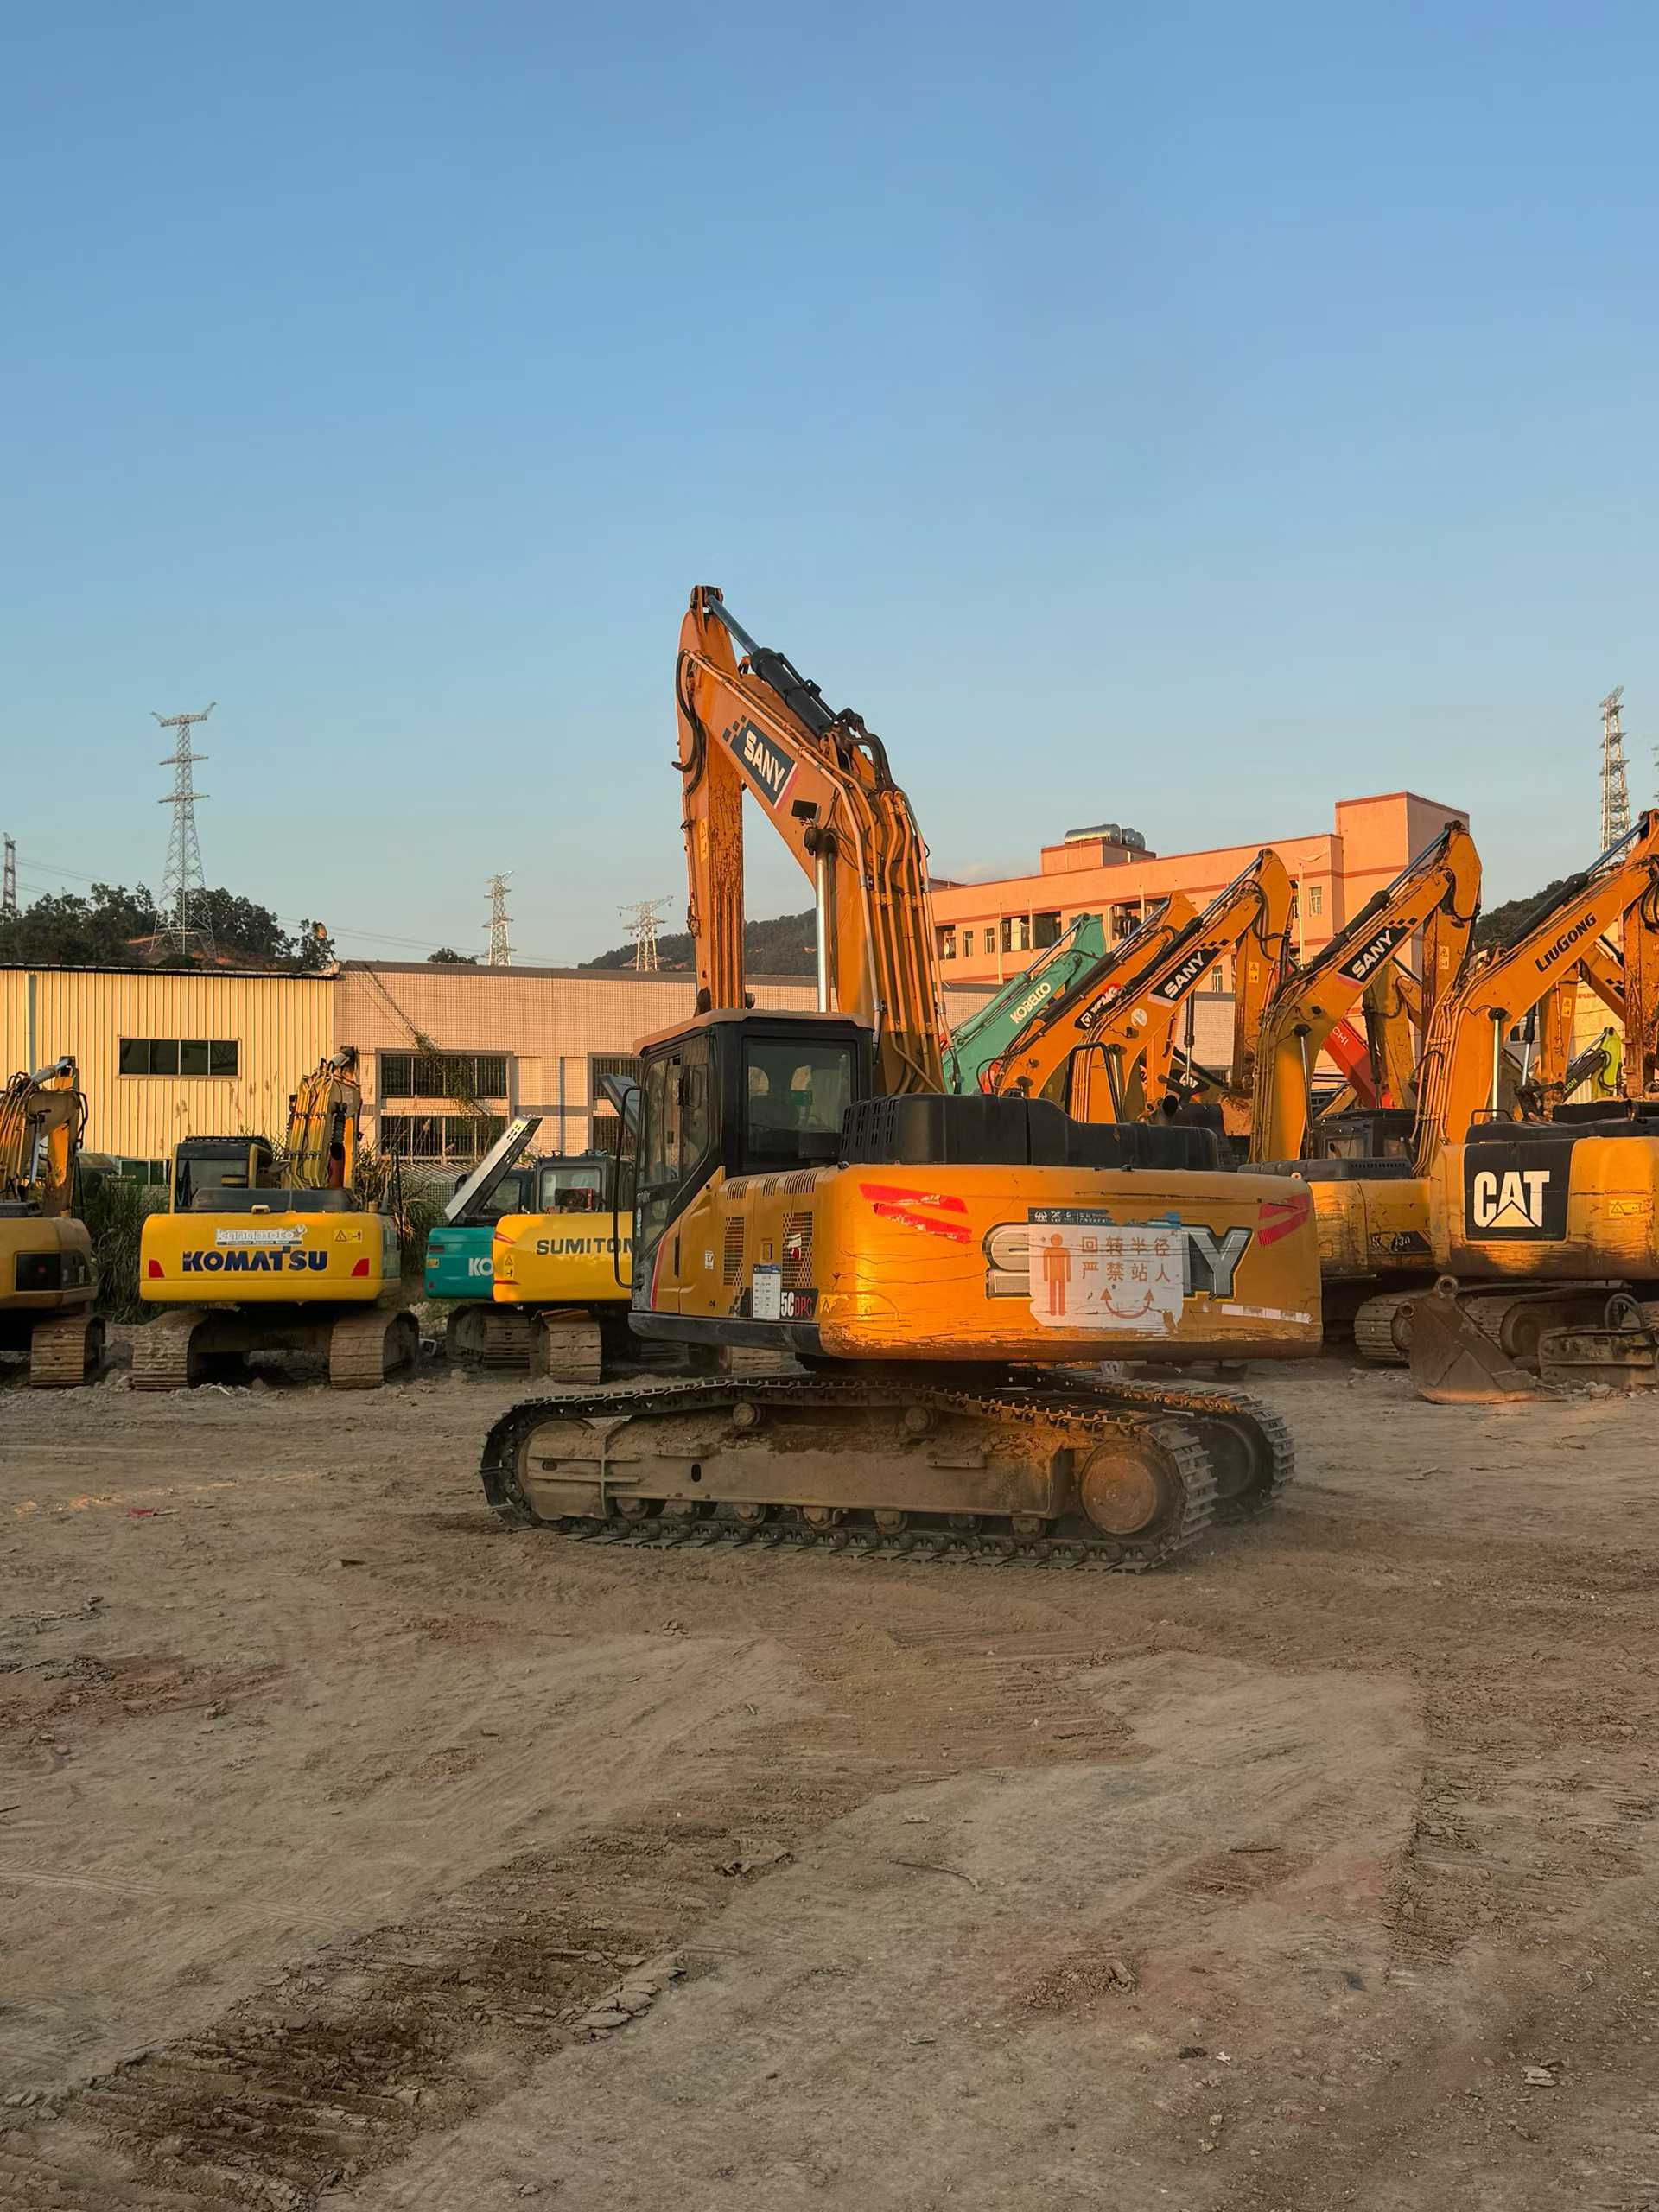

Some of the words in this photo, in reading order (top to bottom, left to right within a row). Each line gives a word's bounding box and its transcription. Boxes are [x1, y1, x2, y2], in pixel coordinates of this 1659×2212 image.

[744, 730, 785, 792] SANY
[1352, 930, 1392, 978] SANY
[1535, 912, 1597, 973] LIUGONG
[1164, 952, 1205, 998] SANY
[1010, 982, 1051, 1024] KOBELCO
[1474, 1171, 1550, 1227] CAT
[182, 1246, 327, 1271] KOMATSU
[1082, 1236, 1170, 1257] 回转半径
[1082, 1261, 1171, 1282] 严禁站人
